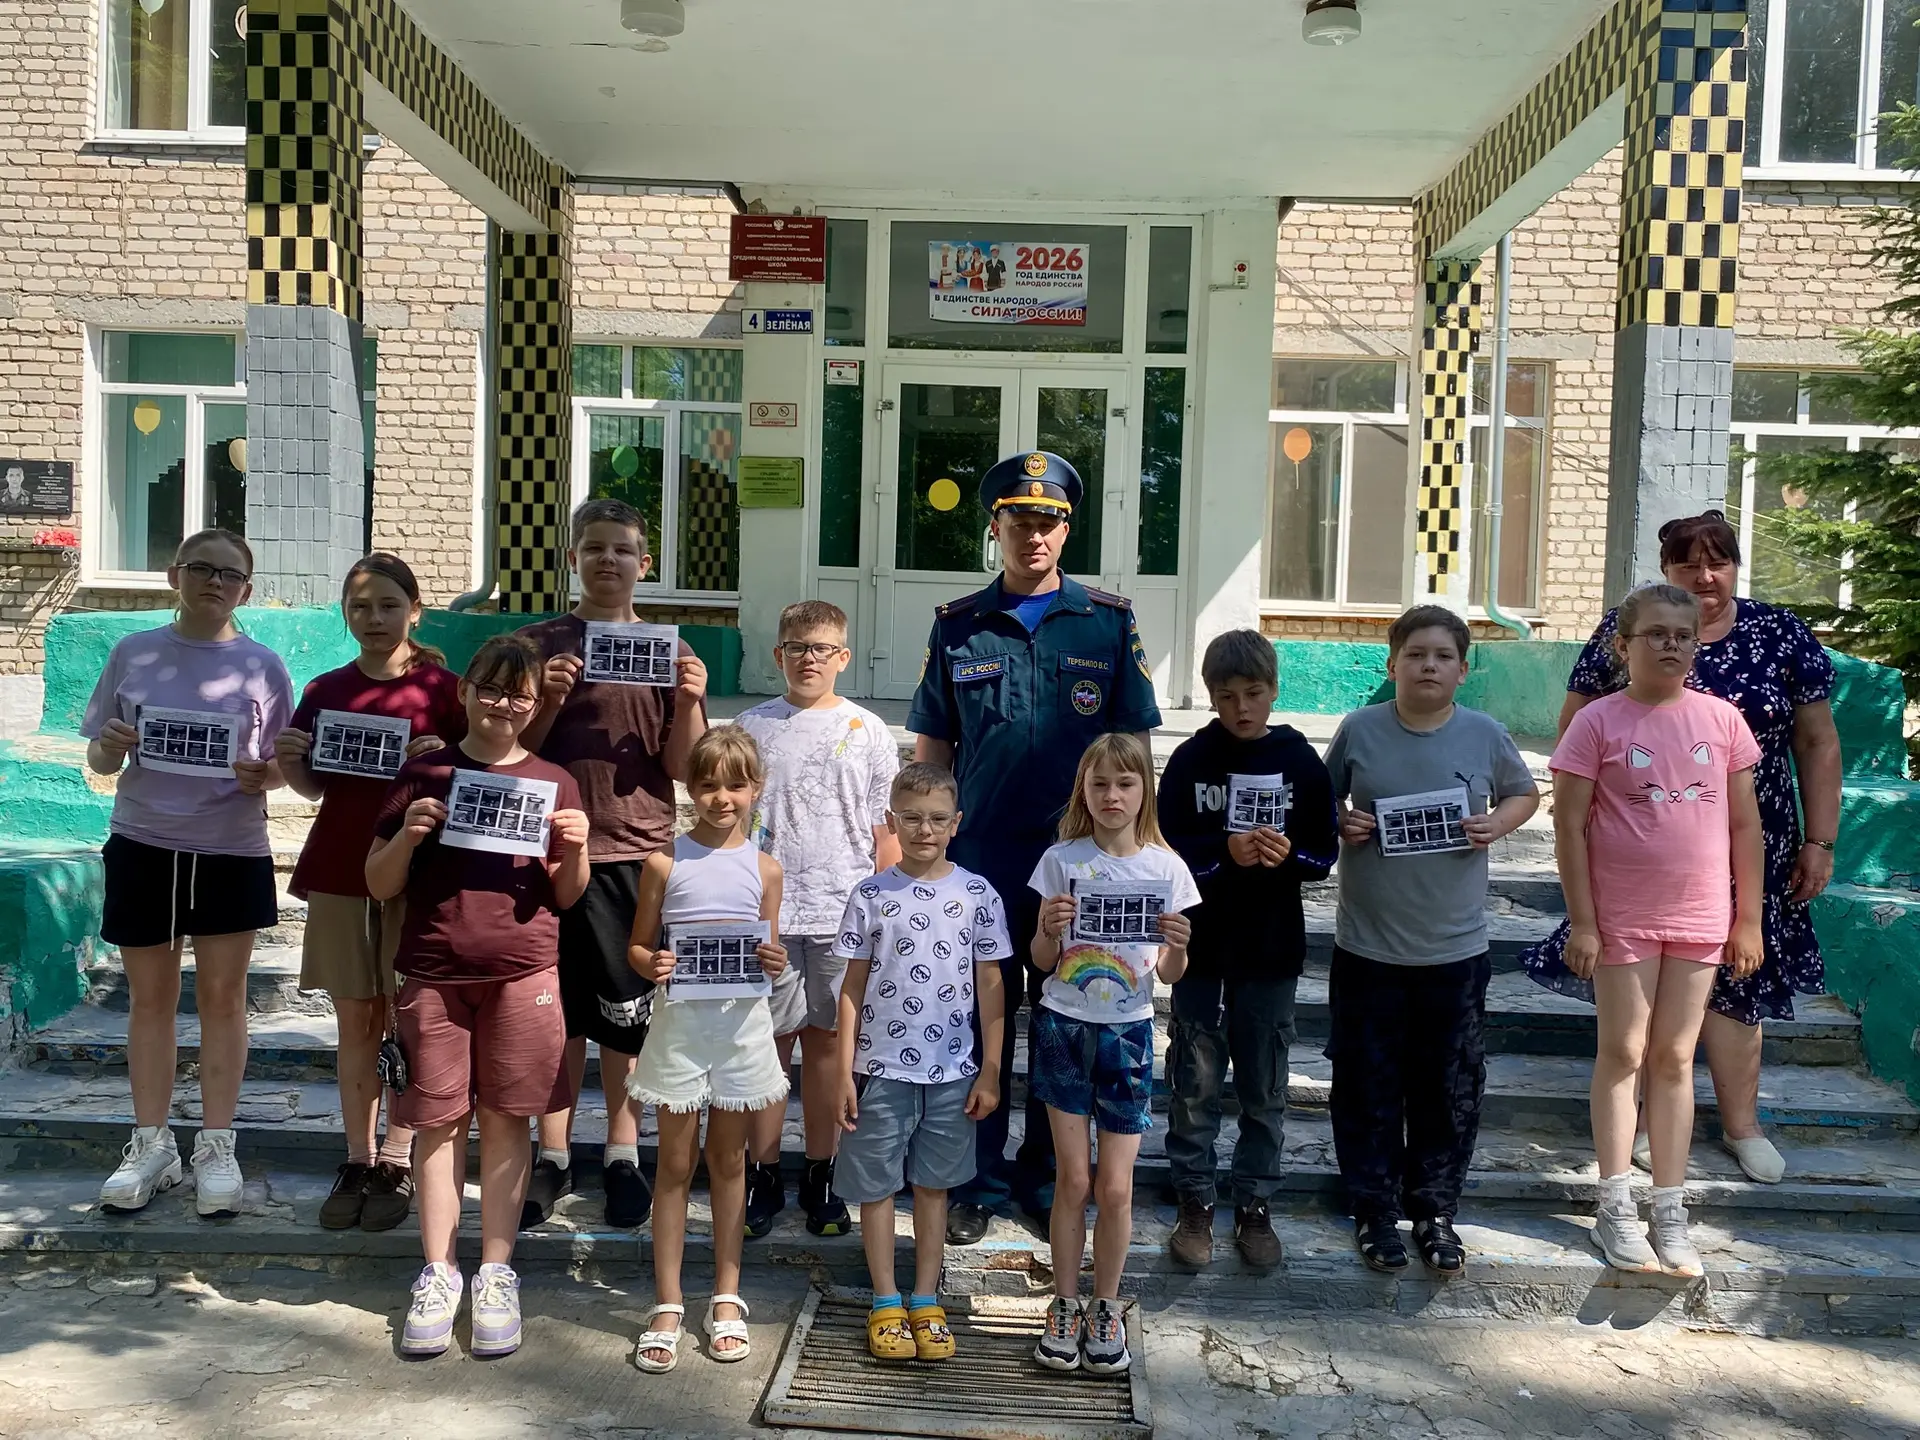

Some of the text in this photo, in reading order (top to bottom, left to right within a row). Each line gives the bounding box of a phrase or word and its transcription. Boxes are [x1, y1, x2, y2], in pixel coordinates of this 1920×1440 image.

[1016, 246, 1083, 271] 2026
[943, 295, 990, 304] ЕДИНСТВЕ
[994, 297, 1038, 305] НАРОДОВ
[971, 306, 1012, 317] СИЛА
[1018, 308, 1082, 320] РОССИИ!
[749, 313, 758, 329] 4
[766, 319, 811, 330] ЗЕЛЁНАЯ
[976, 662, 1001, 673] РОССИИ
[536, 989, 552, 1005] alo
